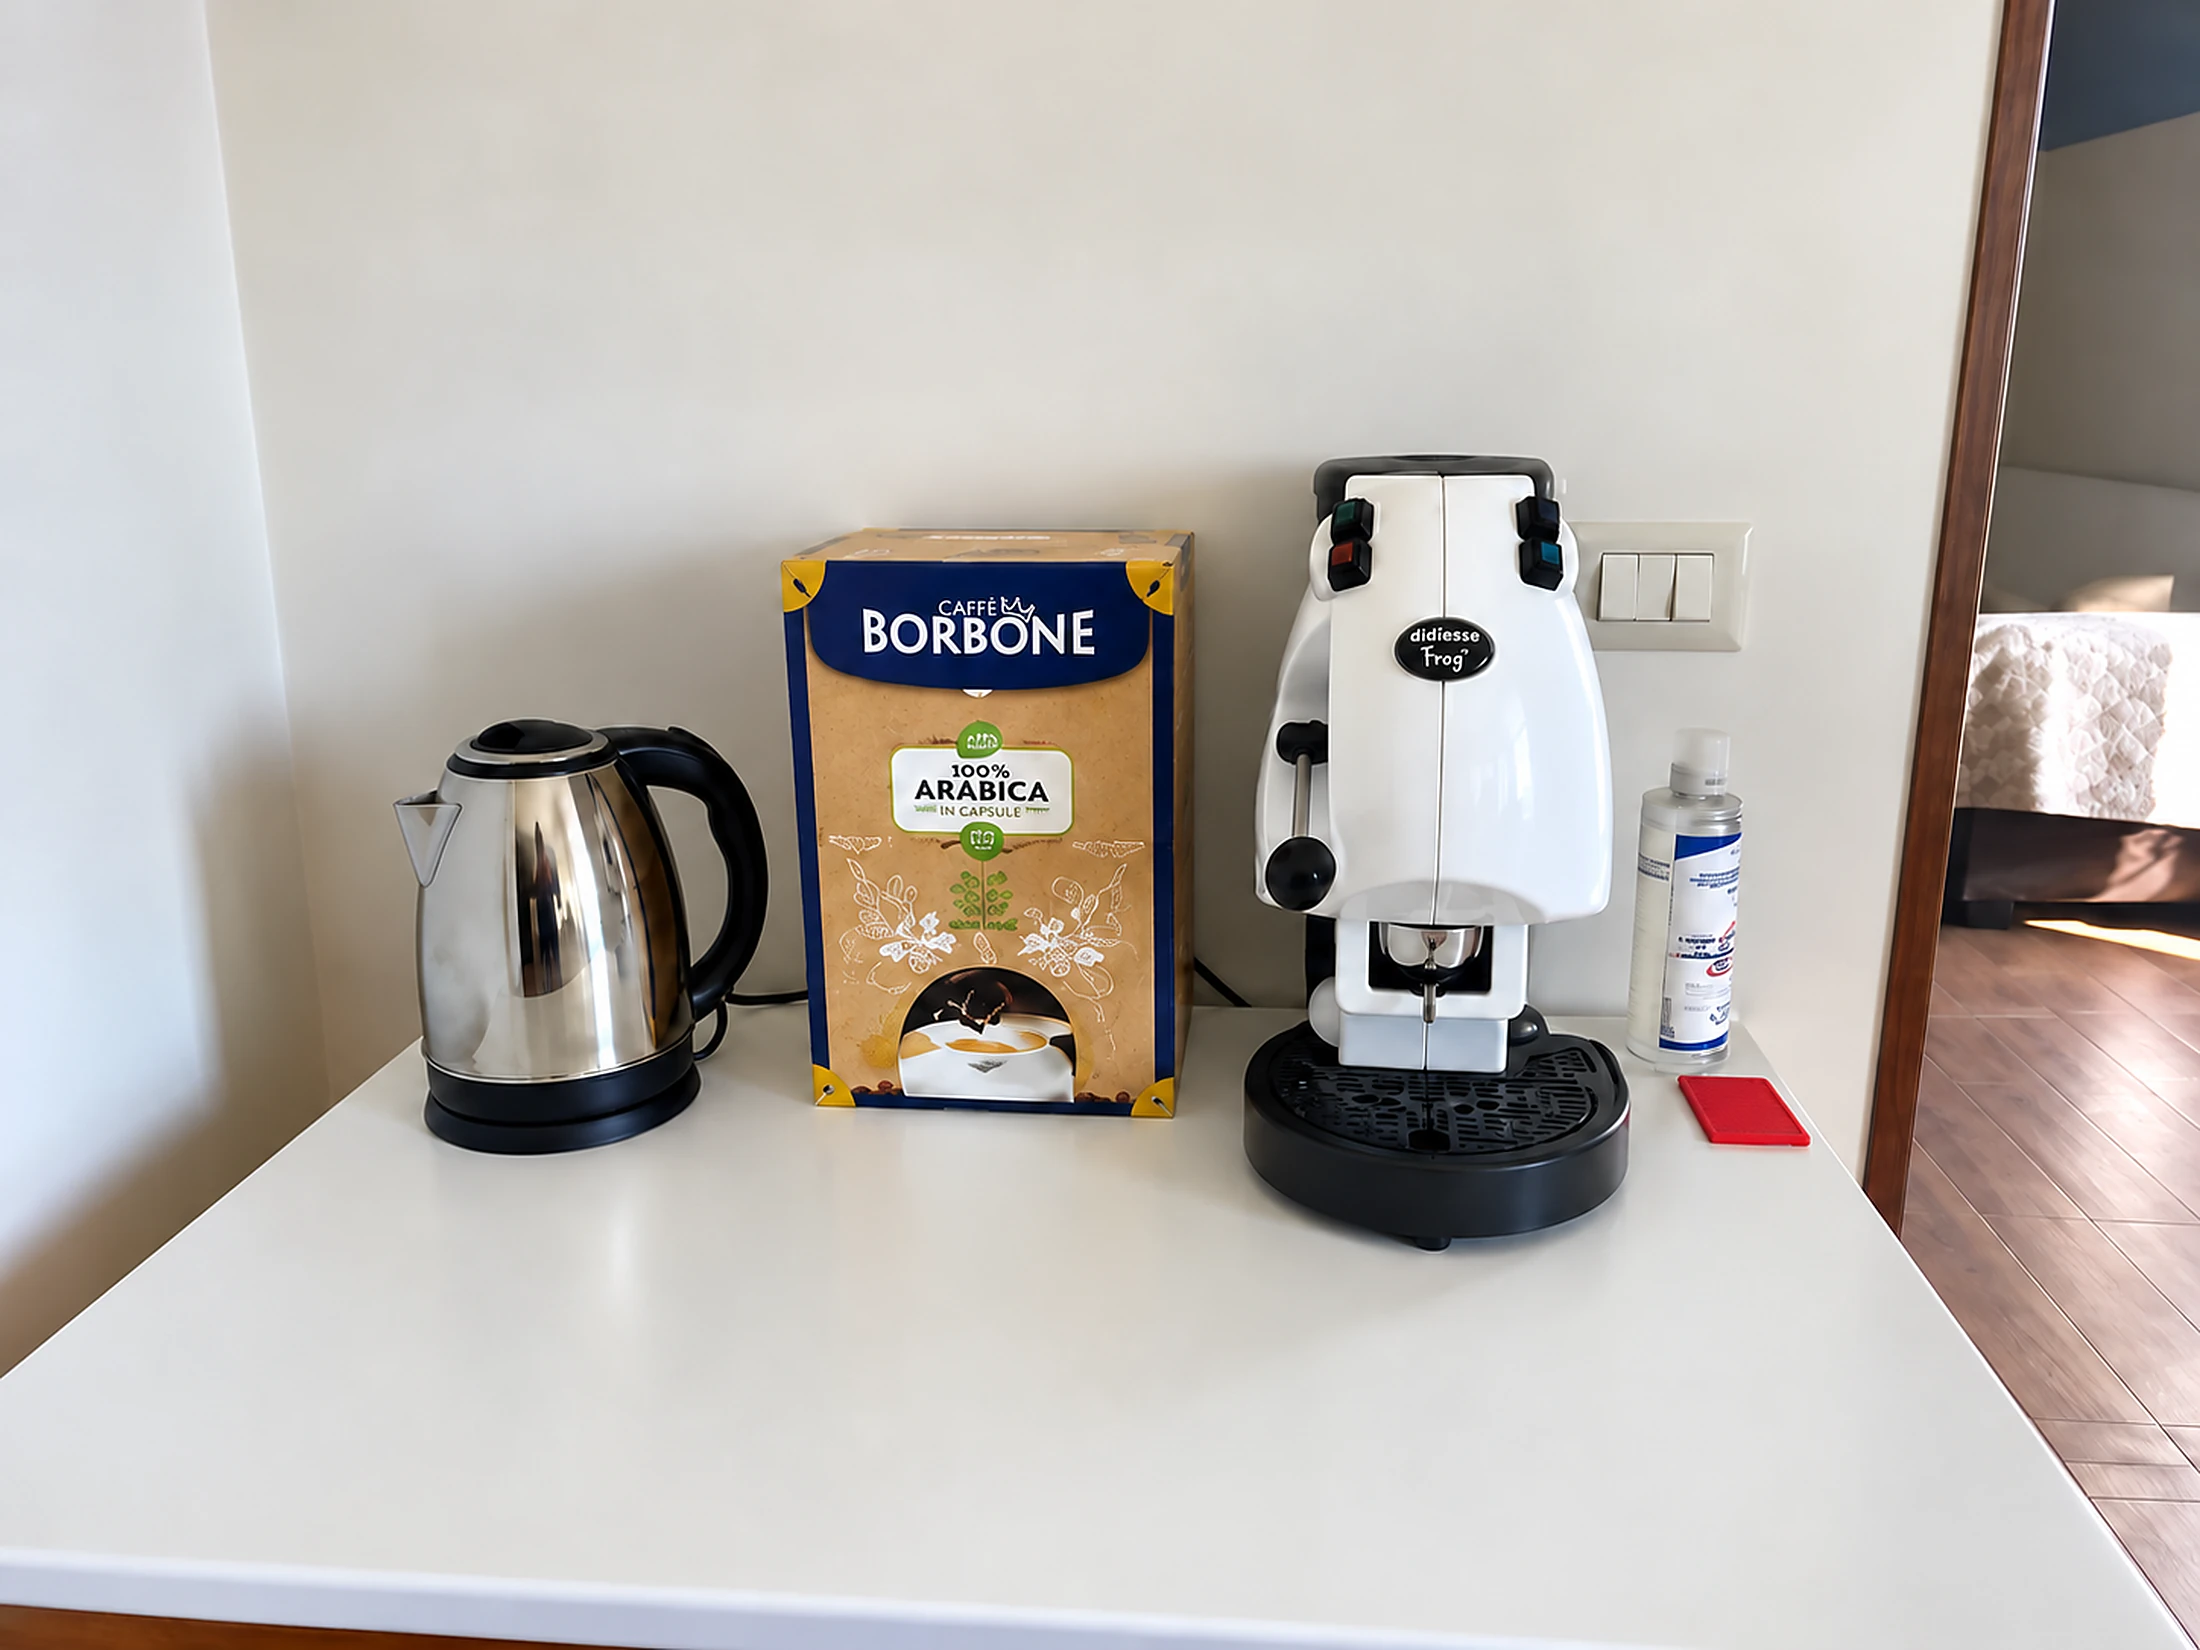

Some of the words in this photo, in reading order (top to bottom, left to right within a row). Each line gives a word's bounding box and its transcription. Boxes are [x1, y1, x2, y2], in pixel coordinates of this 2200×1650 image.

[862, 608, 1095, 655] BORBONE
[1410, 627, 1480, 642] didiesse
[951, 764, 1010, 779] 100%
[914, 779, 1049, 802] ARABICA
[940, 805, 955, 816] IN
[959, 806, 1022, 818] CAPSULE
